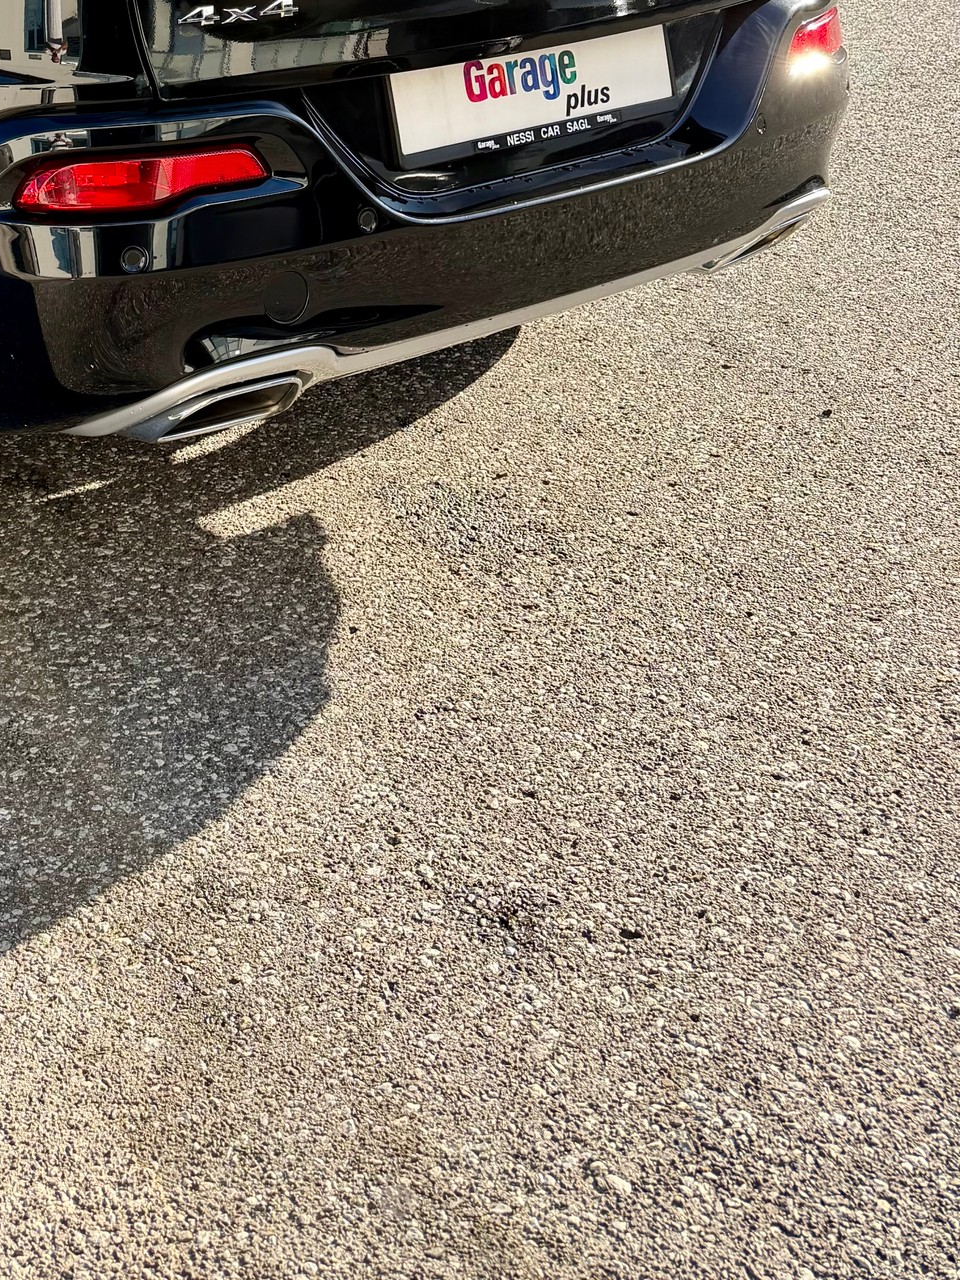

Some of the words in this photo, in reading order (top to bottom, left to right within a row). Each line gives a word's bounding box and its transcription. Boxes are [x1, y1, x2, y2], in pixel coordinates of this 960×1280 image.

[463, 49, 577, 103] Garage
[566, 84, 611, 117] plus
[506, 130, 535, 146] NESSI
[540, 125, 561, 139] CAR
[566, 118, 591, 133] SAGL
